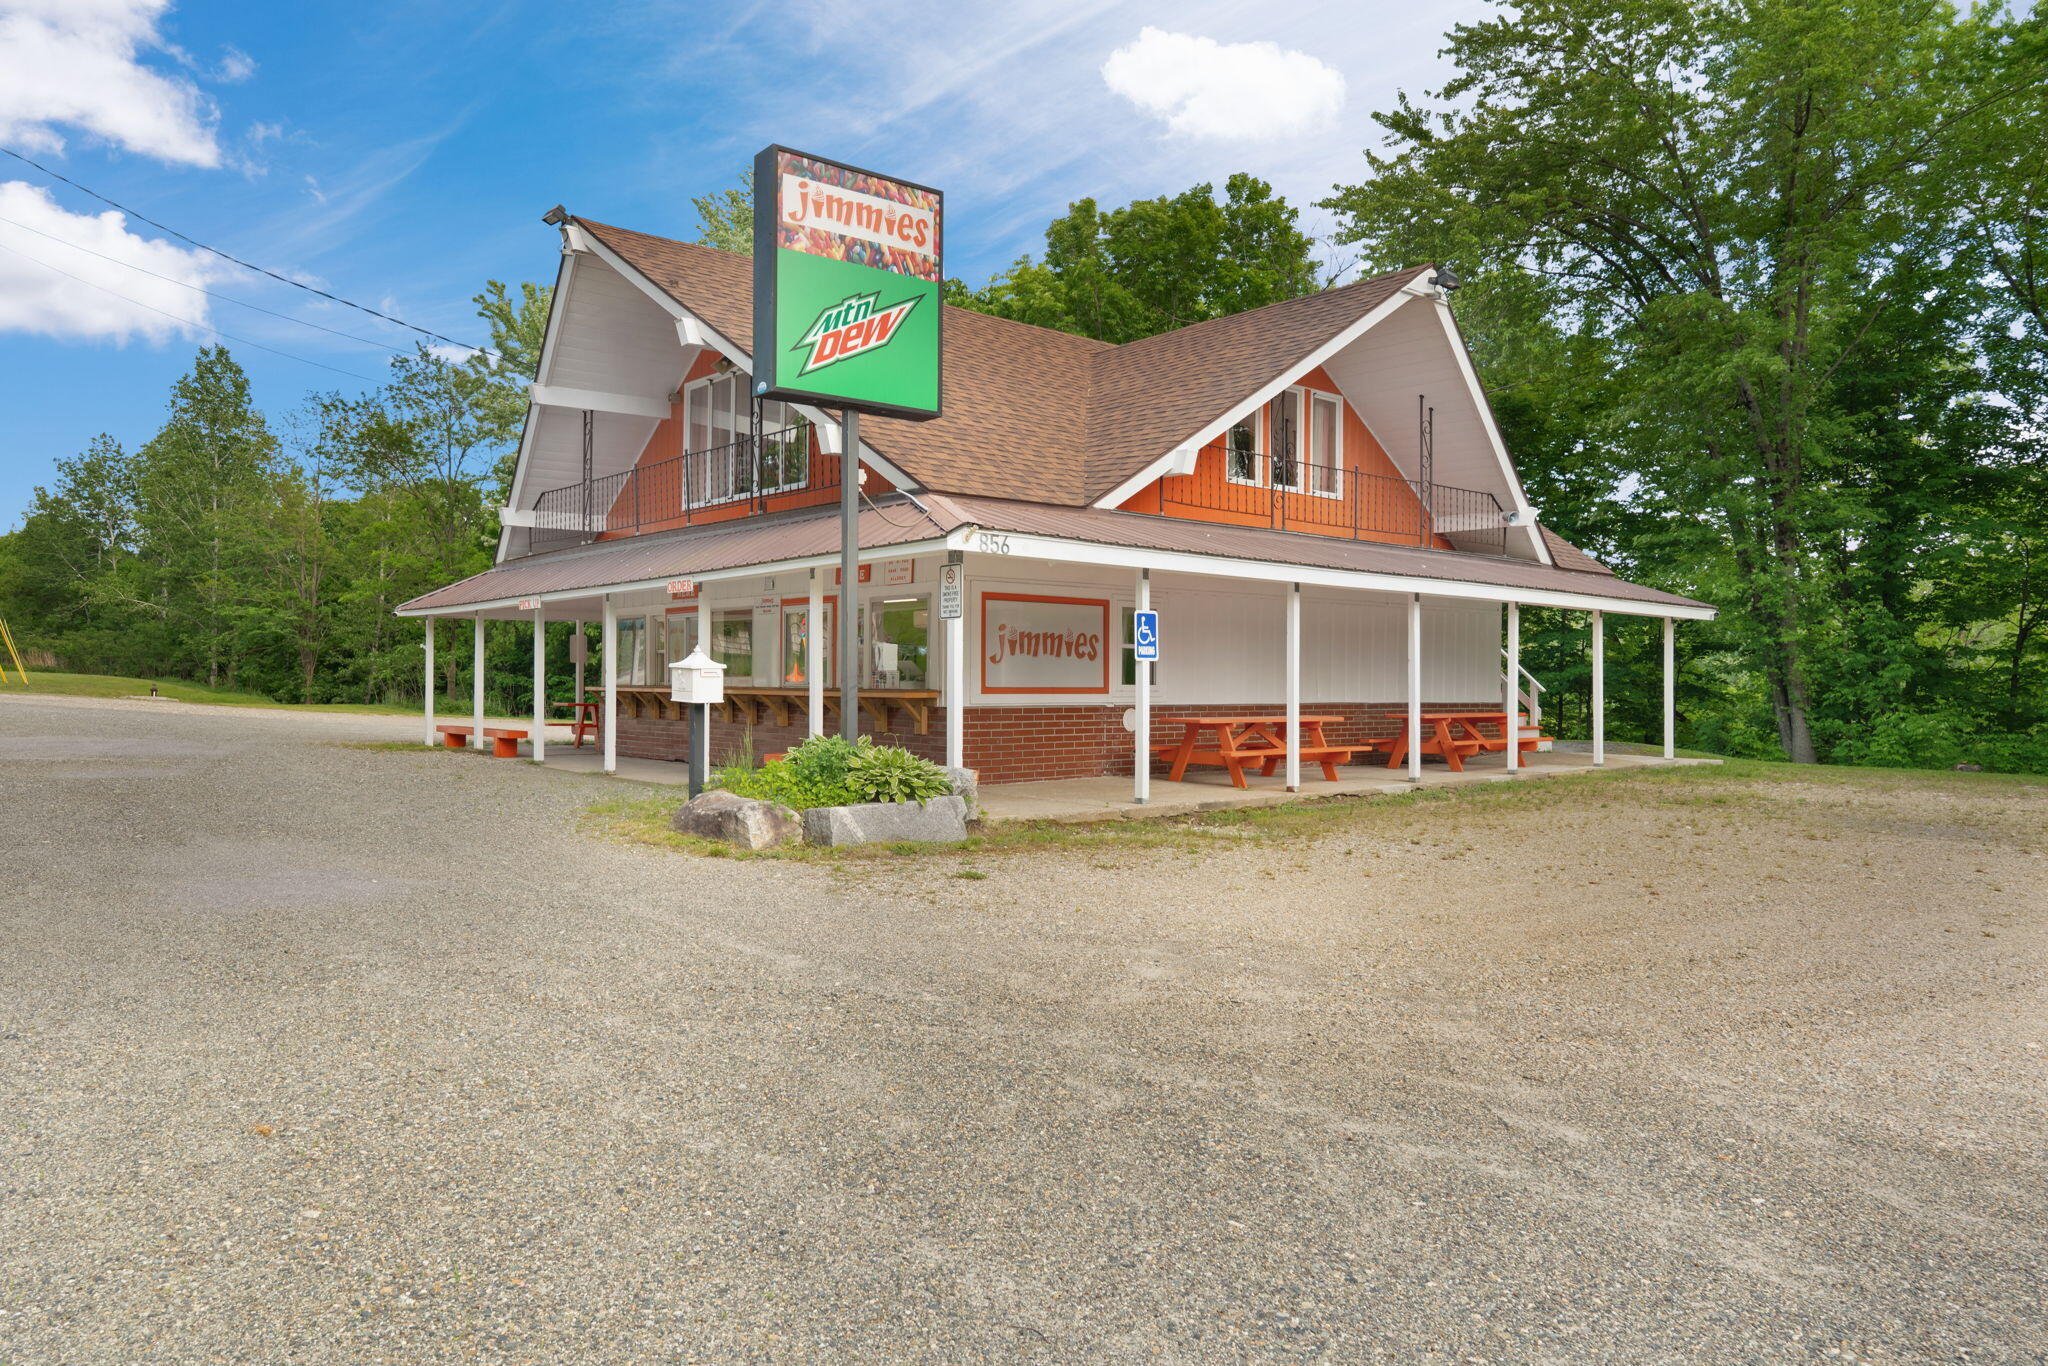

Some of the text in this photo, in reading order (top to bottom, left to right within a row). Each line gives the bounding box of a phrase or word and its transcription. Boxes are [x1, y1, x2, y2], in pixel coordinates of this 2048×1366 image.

[788, 181, 929, 248] jimmies
[980, 533, 1010, 555] 856
[667, 579, 693, 593] ORDER
[989, 624, 1100, 664] jimmies
[1138, 645, 1156, 656] PARKING
